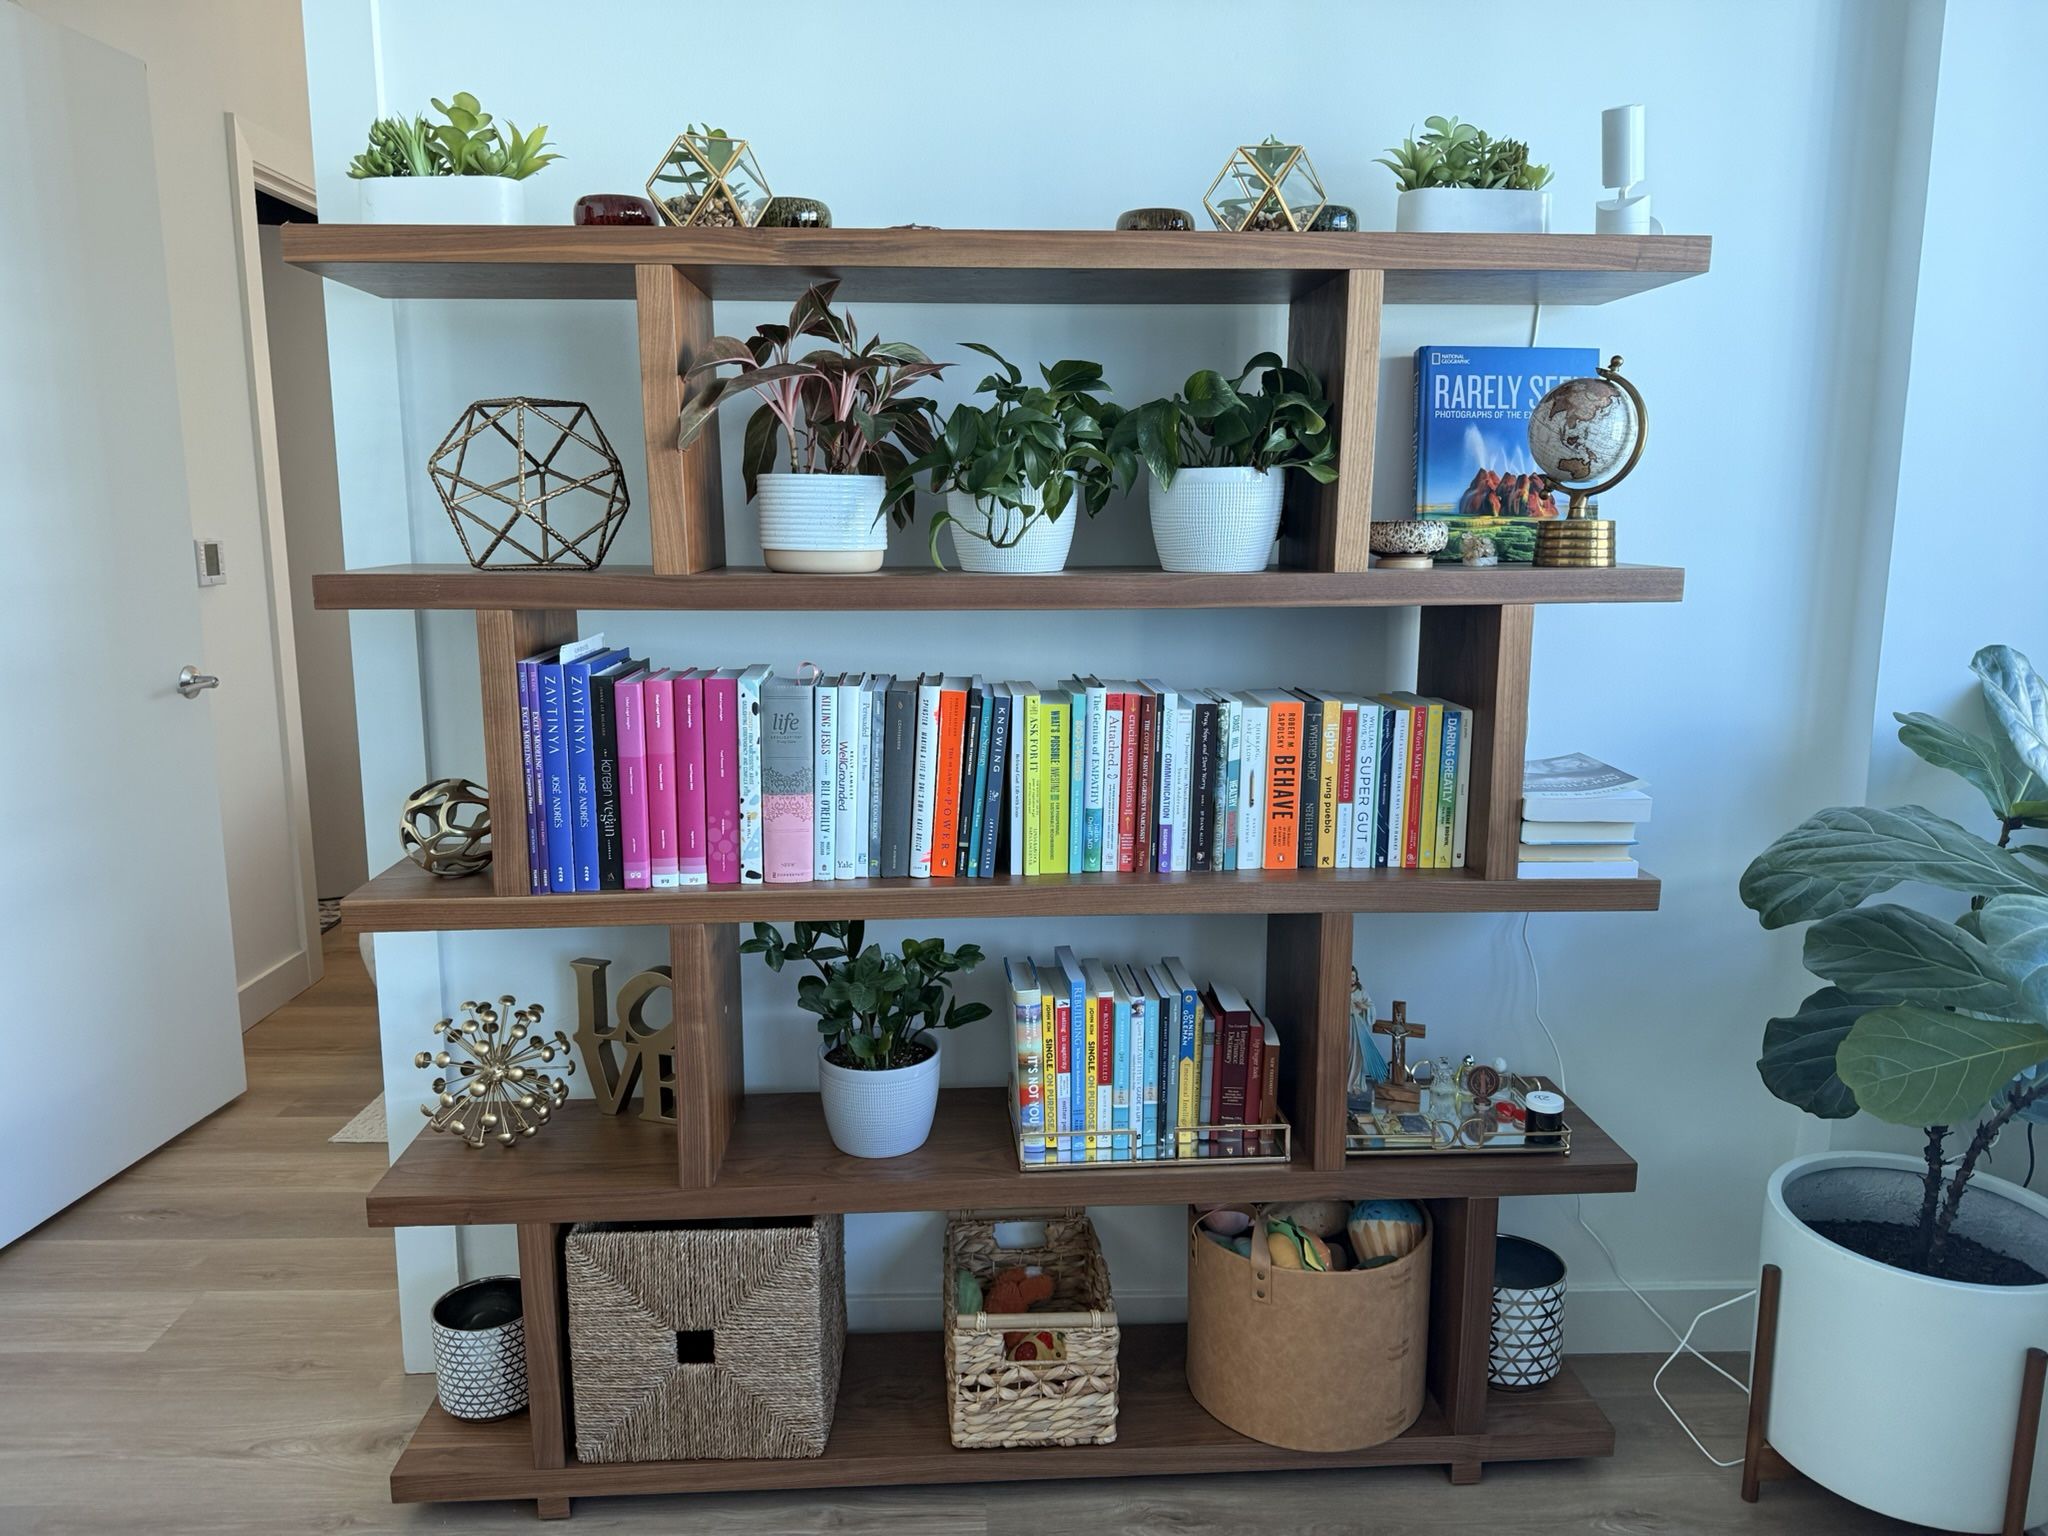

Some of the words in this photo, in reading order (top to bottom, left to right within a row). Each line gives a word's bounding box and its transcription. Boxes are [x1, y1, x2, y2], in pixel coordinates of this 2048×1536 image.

[1434, 374, 1523, 410] RARELY
[1434, 410, 1493, 419] PHOTOGRAPHS
[1494, 411, 1505, 419] OF
[1507, 411, 1523, 419] THE
[822, 696, 831, 727] KILLING
[1093, 694, 1102, 710] The
[772, 711, 799, 735] life
[862, 703, 870, 738] Persuaded
[1030, 718, 1038, 736] ASK
[1051, 711, 1060, 732] WHAT'S
[1092, 713, 1101, 744] Genius
[1128, 715, 1137, 745] crucial
[1164, 708, 1174, 750] Nonviolent
[1232, 715, 1240, 733] CHASE
[1277, 713, 1286, 748] SAPOLSKY
[1288, 713, 1296, 739] ROBERT
[1416, 711, 1425, 728] Love
[522, 731, 534, 766] MODELING
[821, 731, 831, 755] JESUS
[993, 707, 1006, 773] KNOWING
[1030, 739, 1038, 759] FOR
[1108, 716, 1119, 770] Attached.
[1202, 728, 1210, 743] Hope,
[1287, 741, 1294, 750] M.
[1308, 725, 1318, 759] GRISHAM
[1324, 724, 1338, 764] lighter
[1361, 740, 1366, 751] MD
[1415, 730, 1423, 751] Worth
[1446, 718, 1457, 756] DARING
[534, 735, 544, 771] MODELING
[978, 738, 989, 768] Strategy
[1092, 747, 1100, 756] of
[602, 760, 614, 796] korean
[838, 742, 849, 812] WellGrounded
[1030, 762, 1038, 772] IT
[1050, 767, 1060, 792] INVESTING
[1090, 760, 1100, 804] EMPATHY
[1126, 748, 1135, 808] conversations
[1199, 772, 1207, 790] Worry
[1306, 760, 1318, 781] JOHN
[1343, 764, 1351, 799] TRAVELED
[1359, 756, 1372, 806] SUPER
[1412, 754, 1422, 780] Making
[1442, 758, 1454, 803] GREATLY
[552, 774, 562, 795] JOSÉ
[578, 774, 588, 794] JOSÉ
[821, 780, 831, 797] BILL
[1163, 753, 1172, 818] COMMUNICATION
[1229, 780, 1238, 807] HEALTHY
[1272, 755, 1296, 820] BEHAVE
[1324, 776, 1332, 799] yung
[554, 797, 564, 829] ANDRÉS
[580, 797, 590, 828] ANDRÉS
[601, 800, 616, 837] vegan
[820, 800, 831, 832] O'REILLY
[942, 799, 952, 850] POWER
[1304, 803, 1314, 841] BRETHREN
[1324, 802, 1332, 834] pueblo
[1357, 812, 1369, 843] GUT
[1087, 839, 1093, 850] MD
[1303, 843, 1313, 856] THE
[838, 860, 853, 870] Yale
[1074, 987, 1083, 1045] REBUILDING
[1046, 1038, 1054, 1072] SINGLE.
[1088, 1041, 1096, 1073] SINGLE.
[1224, 1031, 1235, 1064] Dictionary
[1232, 1039, 1240, 1064] Finance
[1239, 1030, 1248, 1065] Investment
[1028, 1056, 1039, 1073] IT'S
[1028, 1077, 1040, 1099] NOT
[1046, 1073, 1054, 1087] ON
[1088, 1075, 1095, 1088] ON
[1182, 1064, 1191, 1098] Emotional
[1029, 1102, 1040, 1124] YOU
